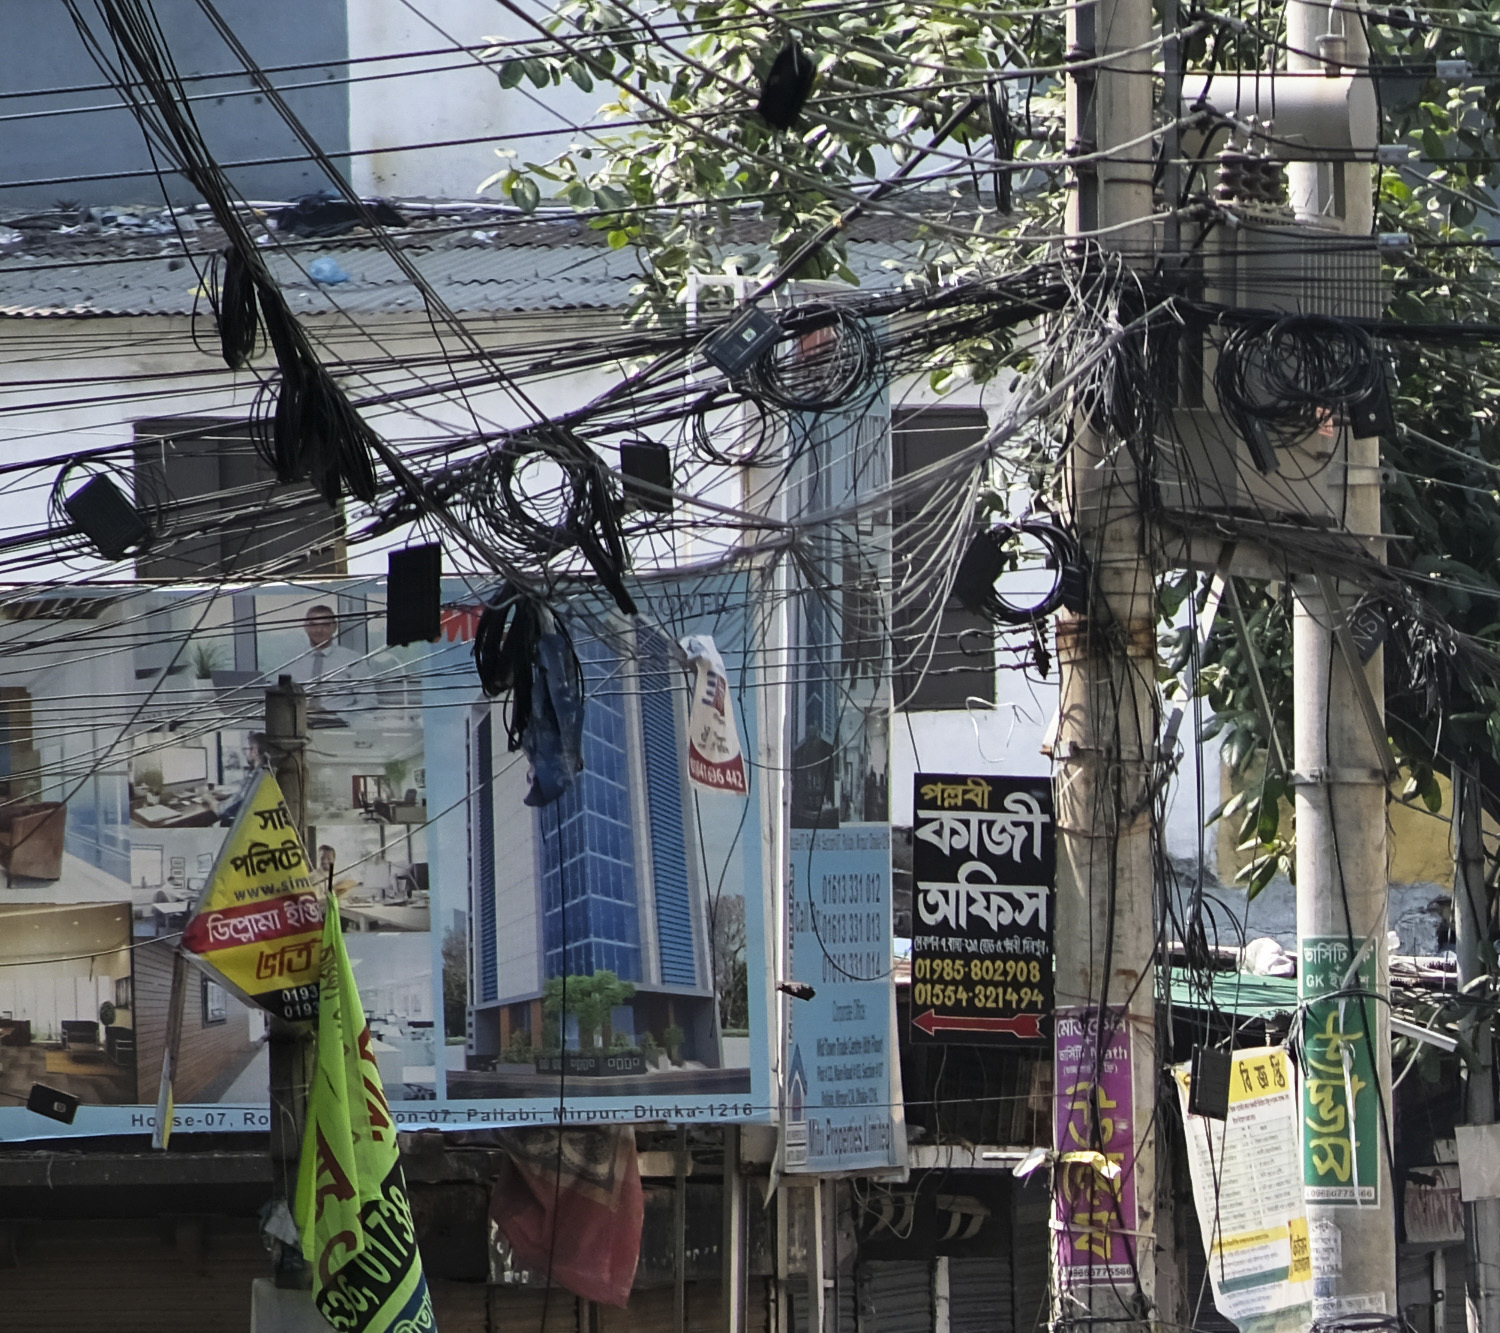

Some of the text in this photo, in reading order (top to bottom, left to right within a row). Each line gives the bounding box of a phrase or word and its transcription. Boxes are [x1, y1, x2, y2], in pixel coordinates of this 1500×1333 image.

[726, 769, 743, 788] 442
[921, 777, 992, 809] পল্লবী
[915, 792, 1050, 863] কাজী
[822, 873, 881, 904] 01613 331 012
[917, 861, 1050, 932] অফিস
[207, 909, 281, 943] ডিপ্লোমা
[849, 912, 863, 944] 331
[865, 912, 881, 944] 013
[1304, 941, 1348, 965] ভার্সিটি
[1306, 974, 1324, 988] GK
[131, 1114, 235, 1128] Hose-07,
